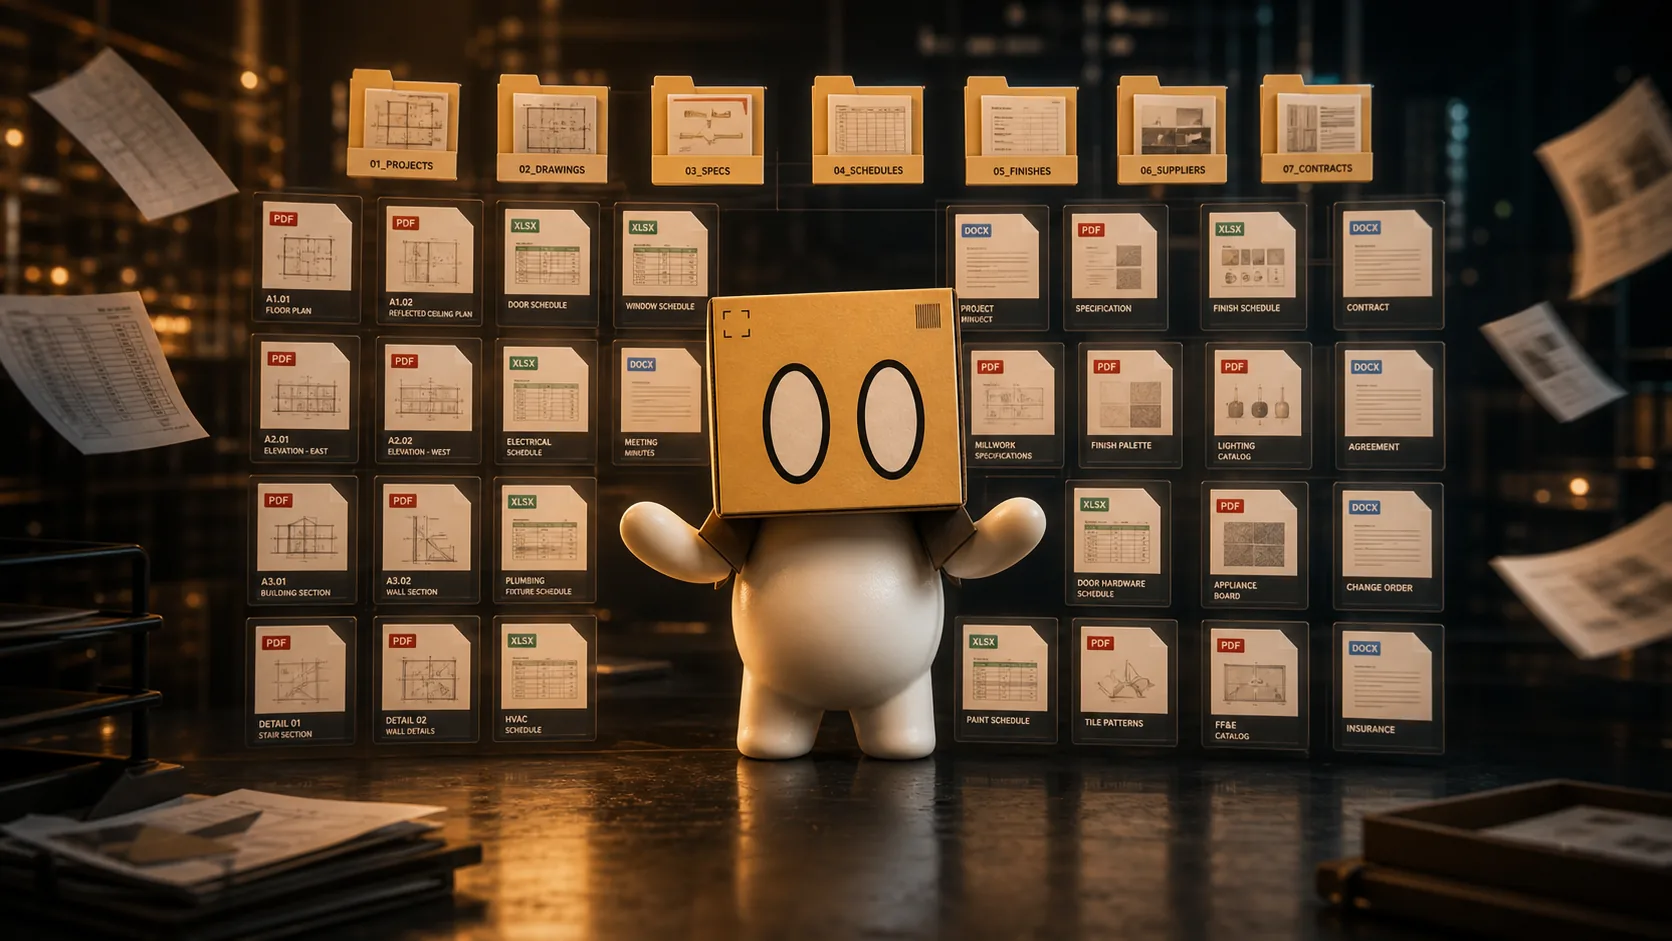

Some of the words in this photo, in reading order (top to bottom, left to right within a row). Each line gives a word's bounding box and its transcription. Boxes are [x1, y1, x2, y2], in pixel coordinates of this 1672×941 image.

[369, 159, 434, 170] 01_PROJECTS
[1282, 163, 1353, 175] 07_CONTRACTS
[519, 164, 586, 175] 02_DRAWINGS
[685, 166, 731, 177] 03_SPECS
[833, 165, 904, 176] 04_SCHEDULES
[993, 166, 1051, 177] 05_FINISHES
[1140, 165, 1206, 176] 06_SUPPLIERS
[273, 214, 294, 224] PDF
[396, 219, 416, 227] PDF
[514, 221, 537, 230] XLSX
[631, 223, 655, 232] XLSX
[1081, 225, 1101, 234] PDF
[1218, 224, 1242, 233] XLSX
[1352, 223, 1379, 232] DOCX
[964, 226, 989, 235] DOCX
[266, 295, 290, 303] A1.01
[389, 298, 413, 307] A1.02
[508, 301, 529, 309] DOOR
[530, 301, 568, 309] SCHEDULE
[625, 302, 658, 310] WINDOW
[658, 302, 695, 311] SCHEDULE
[961, 304, 995, 313] PROJECT
[1075, 304, 1132, 313] SPECIFICATION
[1213, 304, 1239, 312] FINISH
[1240, 304, 1281, 312] SCHEDULE
[1346, 303, 1390, 312] CONTRACT
[265, 306, 291, 314] FLOOR
[292, 307, 312, 315] PLAN
[389, 309, 426, 317] REFLECTED
[427, 310, 454, 318] CEILING
[455, 310, 473, 318] PLAN
[272, 354, 292, 363] PDF
[395, 357, 415, 366] PDF
[512, 359, 535, 368] XLSX
[630, 360, 654, 369] DOCX
[981, 362, 1000, 371] PDF
[1097, 362, 1117, 371] PDF
[1225, 362, 1244, 371] PDF
[1354, 362, 1380, 372] DOCX
[264, 435, 289, 444] A2.01
[388, 436, 413, 445] A2.02
[506, 438, 552, 446] ELECTRICAL
[624, 438, 658, 446] MEETING
[975, 441, 1016, 449] MILLWORK
[1091, 441, 1117, 449] FINISH
[1118, 441, 1152, 450] PALETTE
[1217, 442, 1256, 450] LIGHTING
[1348, 442, 1400, 451] AGREEMENT
[263, 447, 304, 455] ELEVATION
[310, 447, 328, 455] EAST
[388, 448, 425, 456] ELEVATION
[431, 448, 451, 456] WEST
[624, 449, 655, 457] MINUTES
[1217, 453, 1251, 461] CATALOG
[268, 496, 289, 505] PDF
[393, 496, 413, 505] PDF
[510, 497, 535, 506] XLSX
[1083, 500, 1106, 509] XLSX
[1220, 502, 1240, 511] PDF
[1352, 503, 1378, 512] DOCX
[261, 577, 286, 586] A3.01
[386, 576, 411, 585] A3.02
[505, 576, 545, 585] PLUMBING
[1077, 579, 1100, 587] DOOR
[1101, 579, 1146, 588] HARDWARE
[1214, 581, 1257, 590] APPLIANCE
[1346, 583, 1382, 592] CHANGE
[1383, 583, 1413, 592] ORDER
[260, 589, 297, 597] BUILDING
[386, 588, 406, 596] WALL
[407, 588, 438, 596] SECTION
[536, 587, 572, 596] SCHEDULE
[1077, 590, 1114, 598] SCHEDULE
[1214, 592, 1241, 600] BOARD
[266, 638, 287, 647] PDF
[392, 636, 413, 645] PDF
[510, 636, 534, 645] XLSX
[972, 637, 995, 646] XLSX
[1091, 639, 1110, 648] PDF
[1221, 641, 1241, 650] PDF
[1352, 644, 1378, 653] DOCX
[258, 719, 289, 728] DETAIL
[290, 719, 301, 727] 01
[385, 716, 414, 725] DETAIL
[416, 716, 427, 724] 02
[505, 715, 528, 724] HVAC
[966, 716, 989, 724] PAINT
[990, 716, 1030, 725] SCHEDULE
[1085, 718, 1102, 726] TILE
[1103, 719, 1144, 728] PATTERNS
[1215, 720, 1237, 729] FF&E
[1346, 724, 1396, 734] INSURANCE
[258, 731, 279, 739] STAIR
[280, 730, 312, 738] SECTION
[385, 727, 406, 736] WALL
[407, 727, 435, 735] DETAILS
[505, 726, 542, 734] SCHEDULE
[1215, 732, 1250, 740] CATALOG
